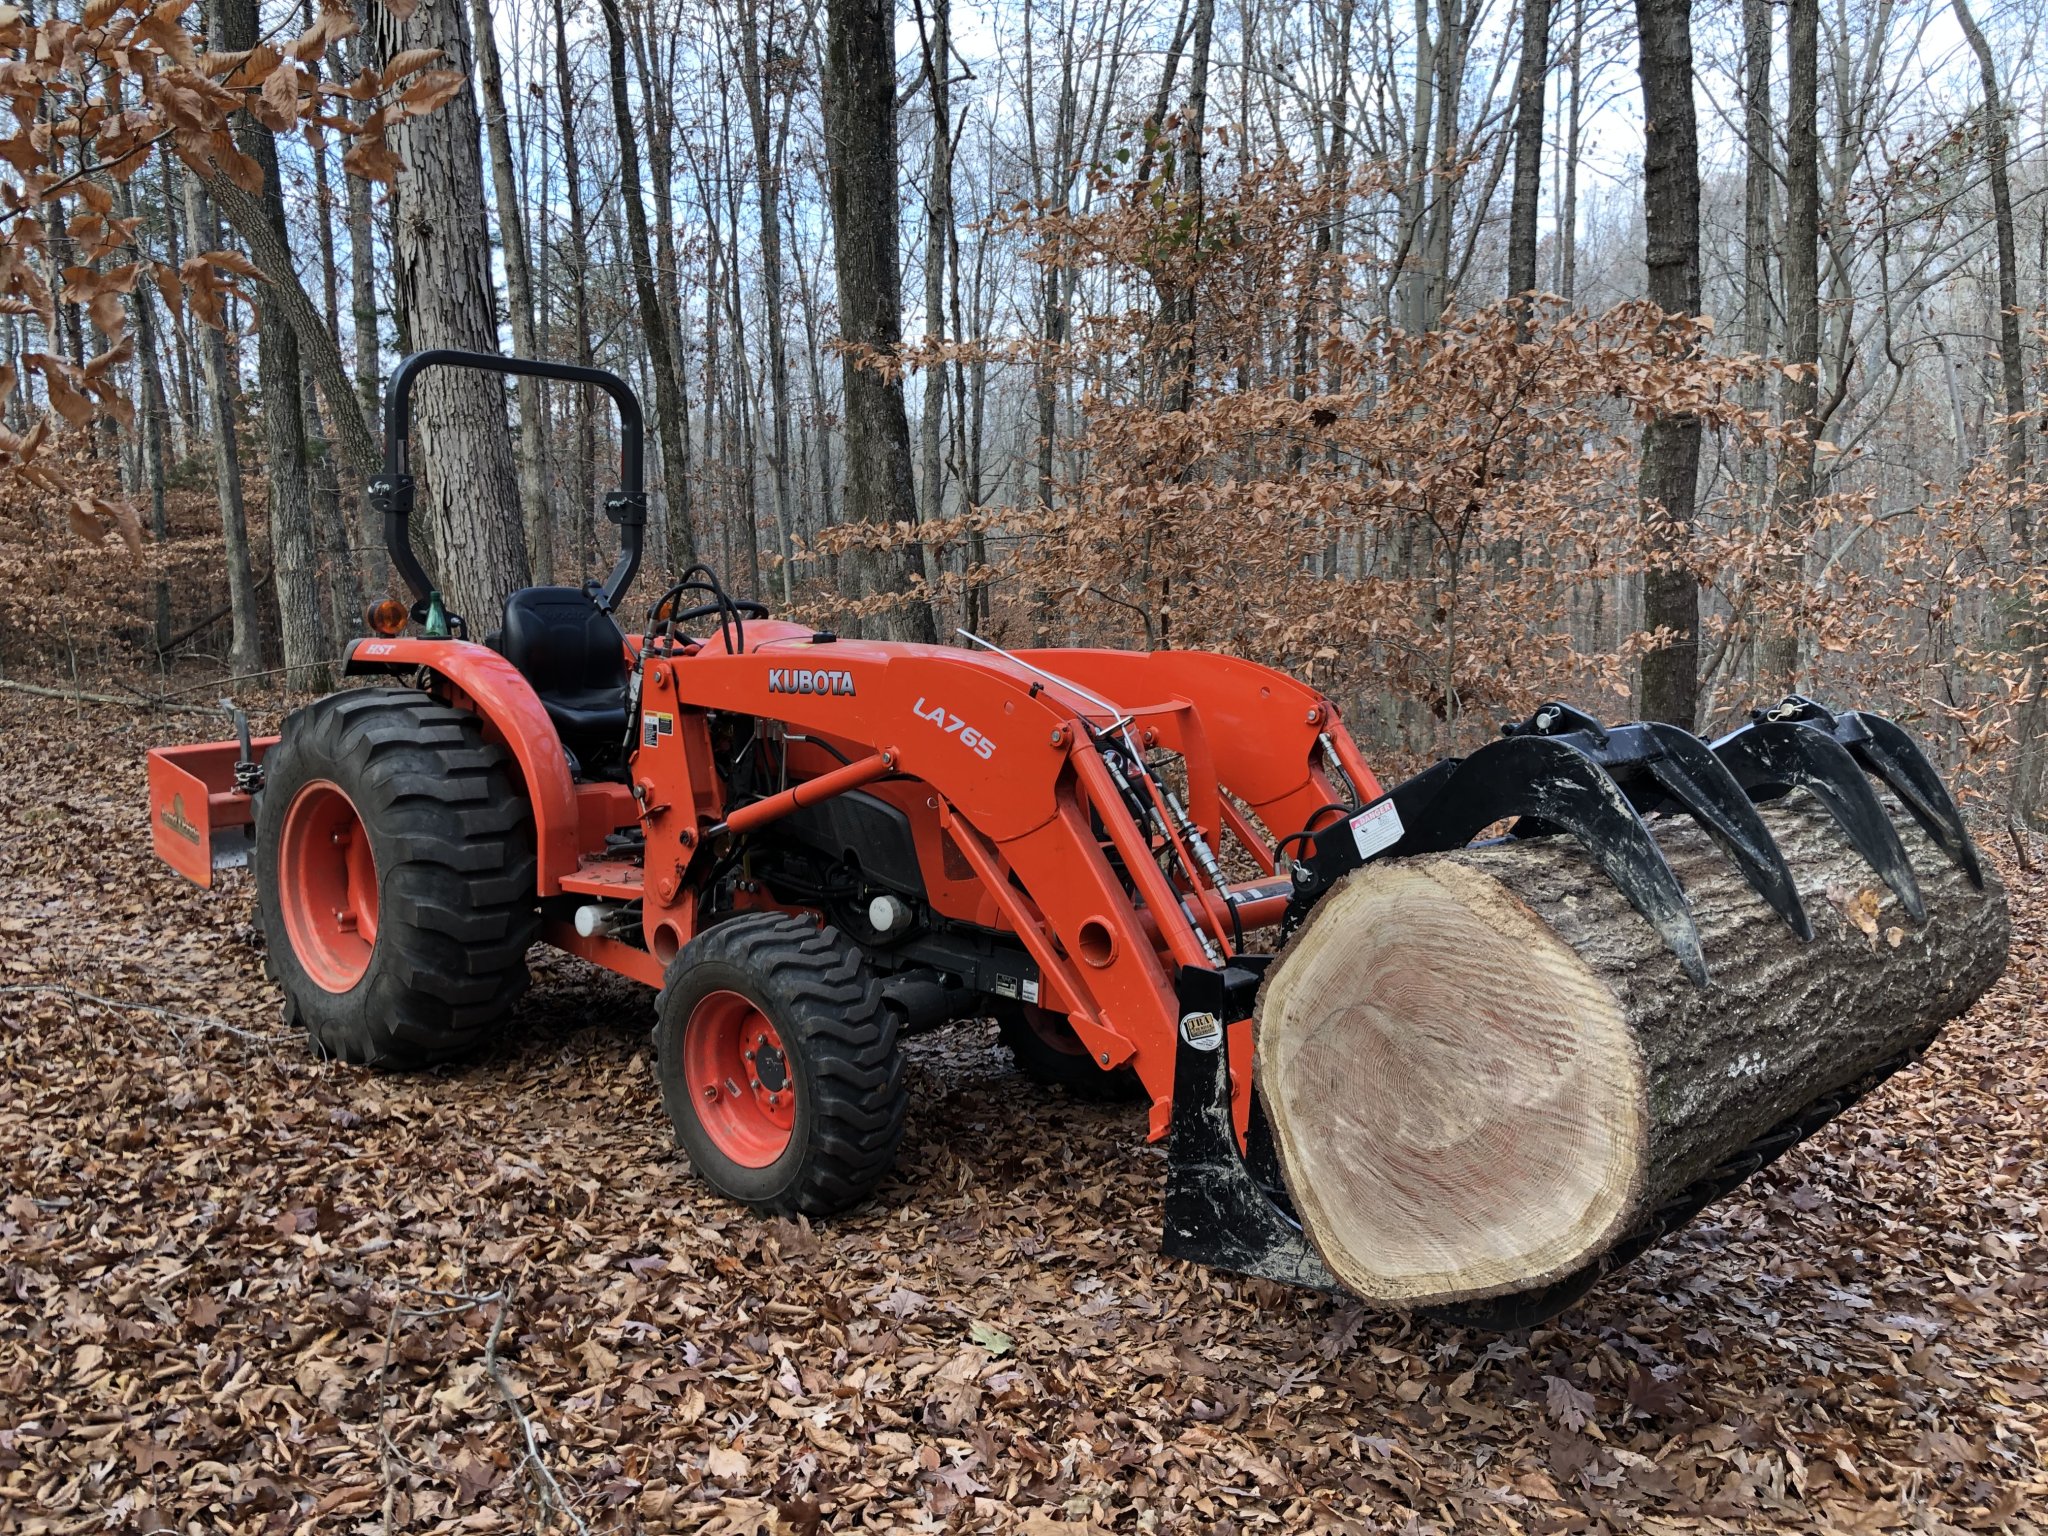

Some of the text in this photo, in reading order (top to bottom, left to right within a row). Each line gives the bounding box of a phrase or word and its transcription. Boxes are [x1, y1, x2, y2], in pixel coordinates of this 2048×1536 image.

[366, 644, 397, 655] HST
[768, 668, 856, 696] KUBOTA
[913, 697, 997, 759] LA765
[1360, 804, 1391, 825] DANGER
